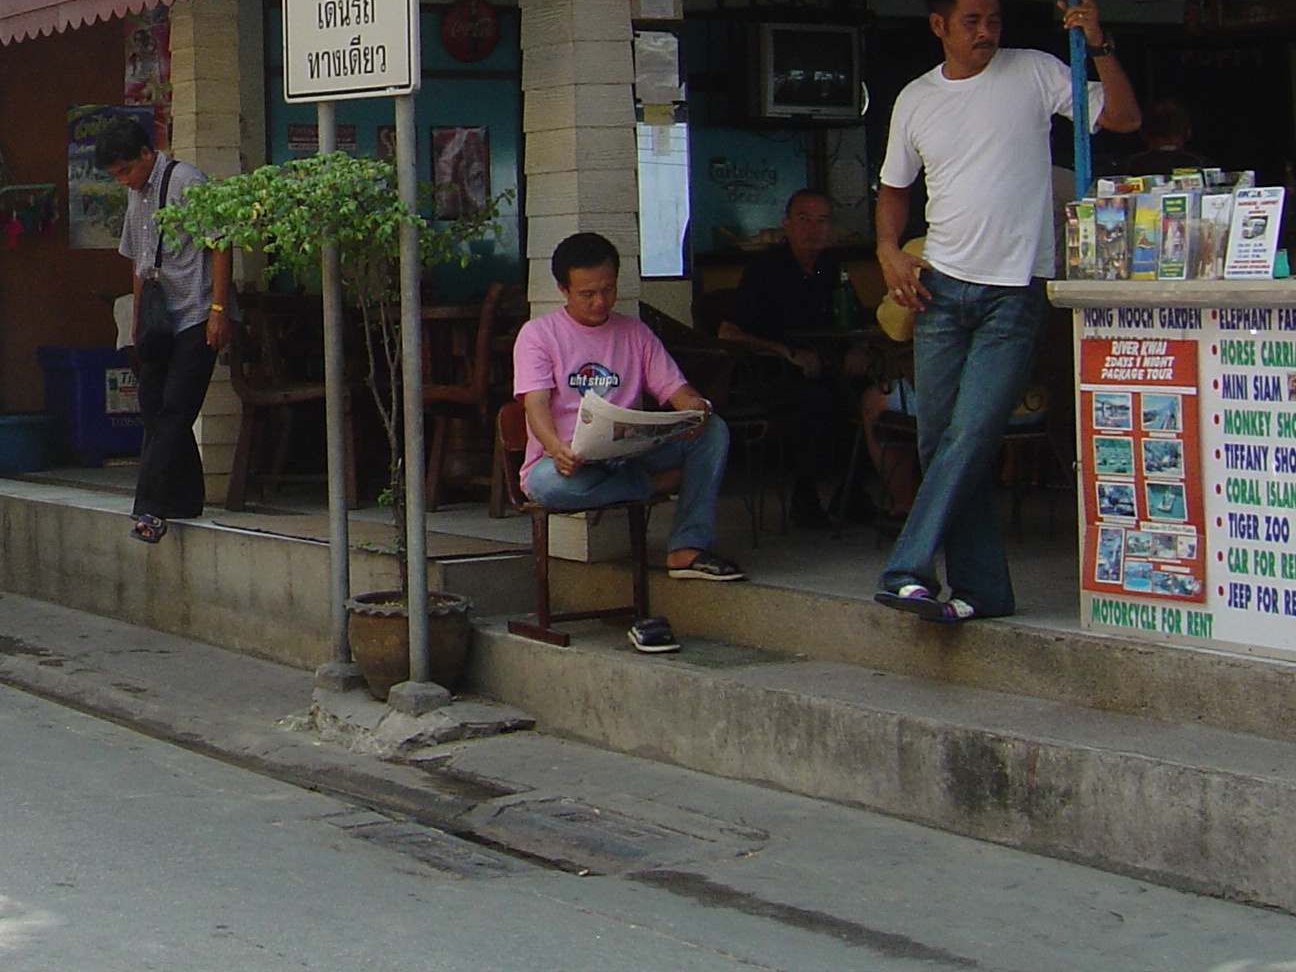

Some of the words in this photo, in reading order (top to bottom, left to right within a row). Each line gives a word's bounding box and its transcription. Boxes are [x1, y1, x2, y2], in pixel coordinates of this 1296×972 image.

[307, 35, 387, 79] ทางเดียว
[1118, 308, 1154, 329] NOOCH
[1158, 308, 1203, 330] GARDEN
[1219, 307, 1272, 330] ELEPHANT
[1111, 341, 1139, 356] RIVER
[1141, 341, 1168, 356] KWAI
[1143, 356, 1176, 368] NIGHT
[1220, 339, 1256, 365] HORSE
[1100, 368, 1146, 380] PACKAGE
[1146, 368, 1174, 380] TOUR
[1222, 374, 1248, 401] MINI
[1253, 375, 1283, 402] SIAM
[1223, 409, 1272, 438] MONKEY
[1224, 443, 1269, 474] TIFFANY
[1225, 477, 1262, 505] CORAL
[1227, 512, 1258, 540] TIGER
[1264, 515, 1290, 544] ZOO
[1227, 546, 1249, 575] CAR
[1253, 548, 1277, 578] FOR
[1280, 550, 1296, 580] RE
[1227, 581, 1251, 609] JEEP
[1257, 583, 1280, 614] FOR
[1091, 597, 1157, 631] MOTORCYCLE
[1161, 606, 1183, 635] FOR
[1186, 611, 1214, 639] RENT
